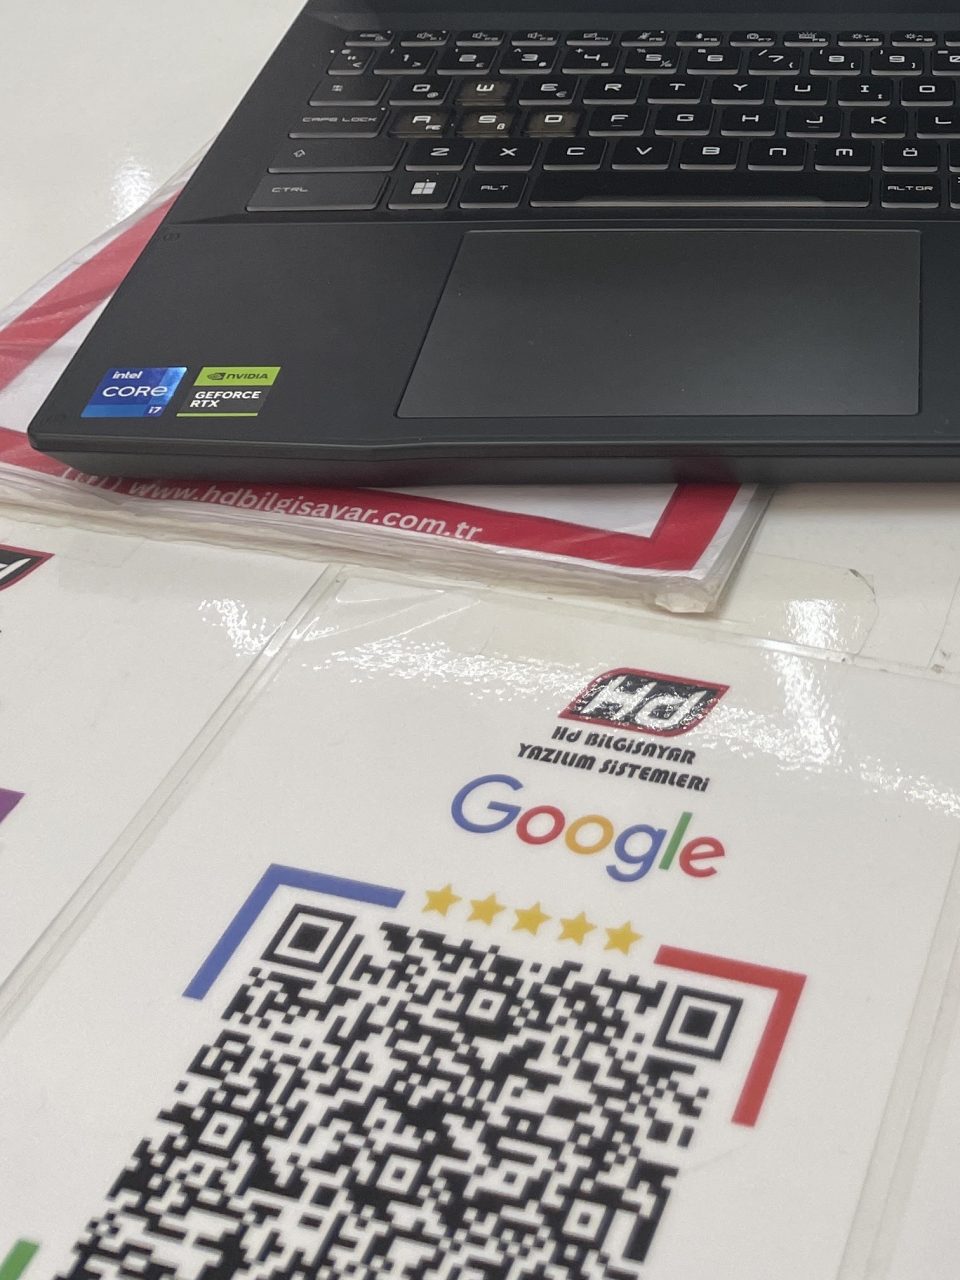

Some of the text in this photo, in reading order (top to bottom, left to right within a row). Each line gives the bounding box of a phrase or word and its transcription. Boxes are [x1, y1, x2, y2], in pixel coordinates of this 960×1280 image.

[459, 54, 477, 62] 2
[521, 54, 538, 62] 3
[584, 54, 600, 62] 4
[646, 54, 662, 62] 5
[707, 54, 724, 62] 6
[768, 54, 784, 63] 7
[828, 55, 845, 63] 8
[889, 55, 905, 63] 9
[412, 84, 431, 93] Q
[476, 83, 494, 92] W
[540, 83, 558, 91] E
[604, 83, 622, 91] R
[669, 83, 686, 91] T
[732, 83, 748, 91] Y
[919, 85, 935, 93] O
[412, 115, 432, 124] A
[478, 115, 496, 123] S
[610, 114, 629, 122] F
[676, 114, 694, 122] G
[741, 114, 759, 122] H
[806, 116, 823, 124] J
[871, 116, 887, 124] K
[935, 116, 952, 124] L
[430, 147, 449, 156] Z
[500, 147, 517, 156] X
[567, 147, 585, 155] C
[636, 147, 652, 155] V
[702, 147, 720, 155] B
[112, 371, 143, 379] intel
[195, 391, 261, 399] GEFORCE
[190, 400, 220, 408] RTX
[148, 406, 162, 415] i7
[129, 480, 483, 542] www.hdbilgisayar.com.tr
[581, 674, 708, 732] Hd
[517, 742, 597, 771] YAZILIM
[451, 774, 725, 883] Google
